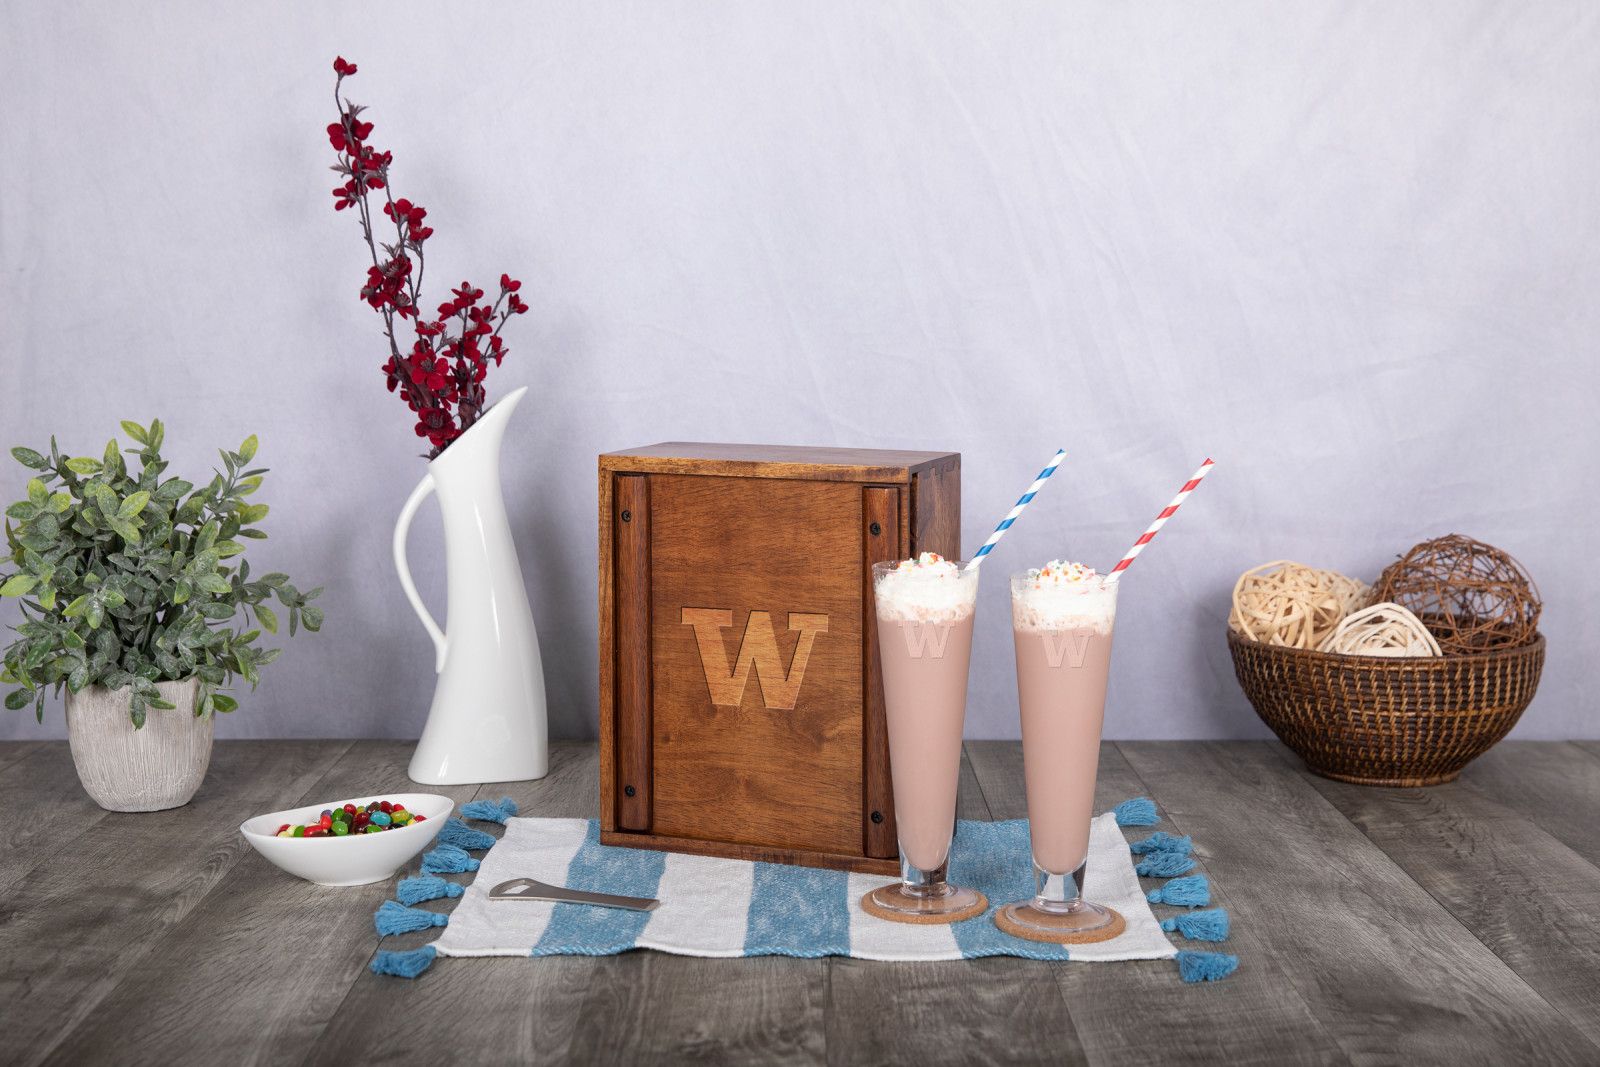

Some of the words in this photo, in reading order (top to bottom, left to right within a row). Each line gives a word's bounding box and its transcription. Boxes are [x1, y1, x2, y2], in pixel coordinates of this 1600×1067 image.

[681, 607, 828, 710] W
[898, 620, 955, 659] W
[1038, 628, 1095, 668] W
